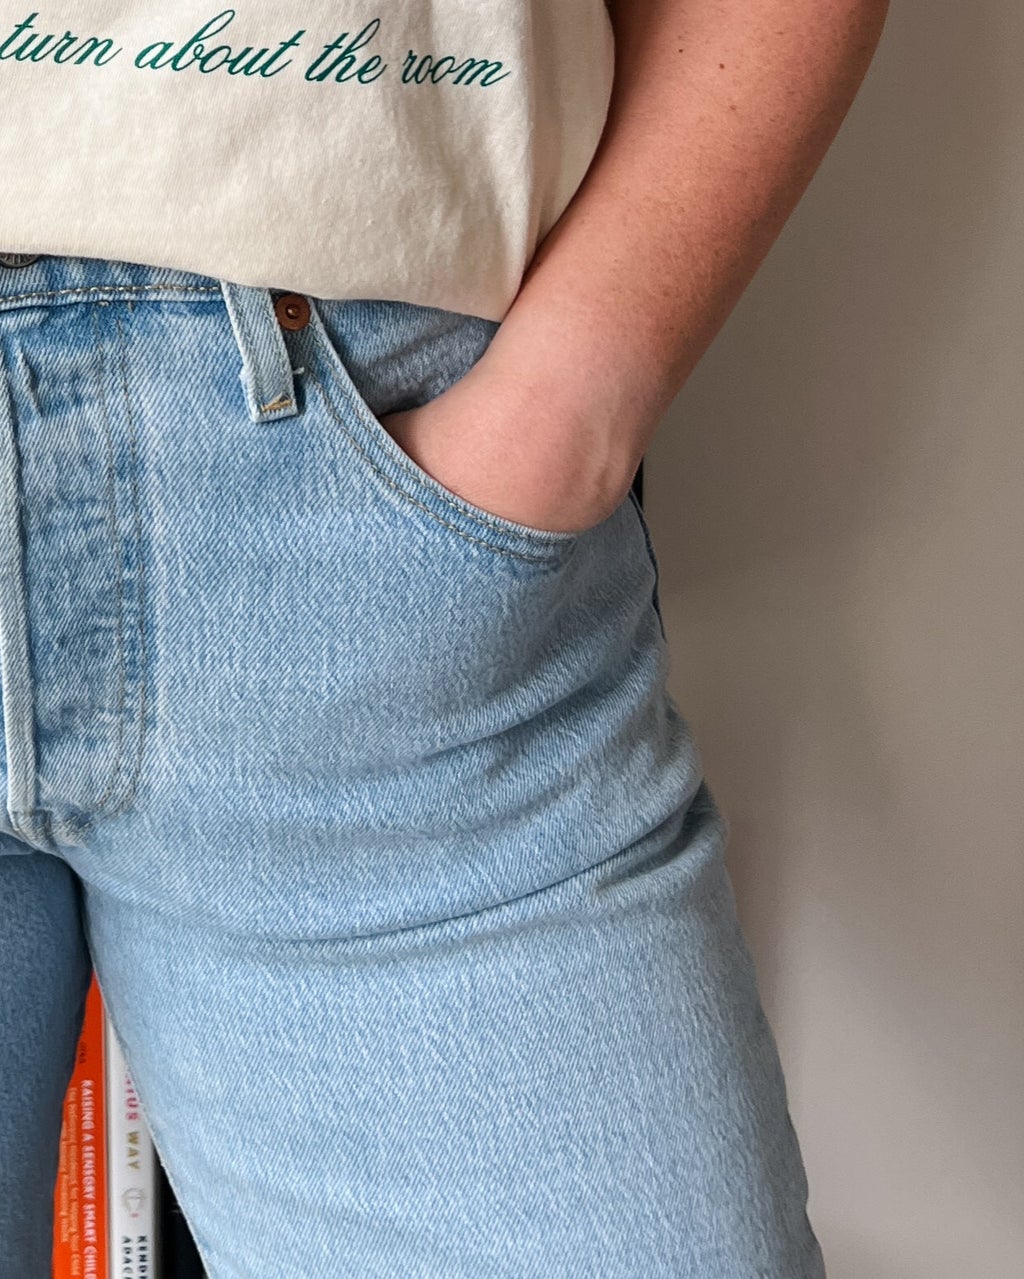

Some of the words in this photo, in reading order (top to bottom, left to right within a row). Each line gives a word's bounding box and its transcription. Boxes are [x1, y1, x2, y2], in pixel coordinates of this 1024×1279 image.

[134, 9, 307, 79] about
[304, 18, 387, 85] the
[402, 48, 511, 87] room
[81, 1080, 95, 1129] RAISING
[82, 1134, 95, 1143] A
[127, 1131, 141, 1170] WAY
[82, 1146, 96, 1200] SENSORY
[84, 1204, 98, 1243] SMART
